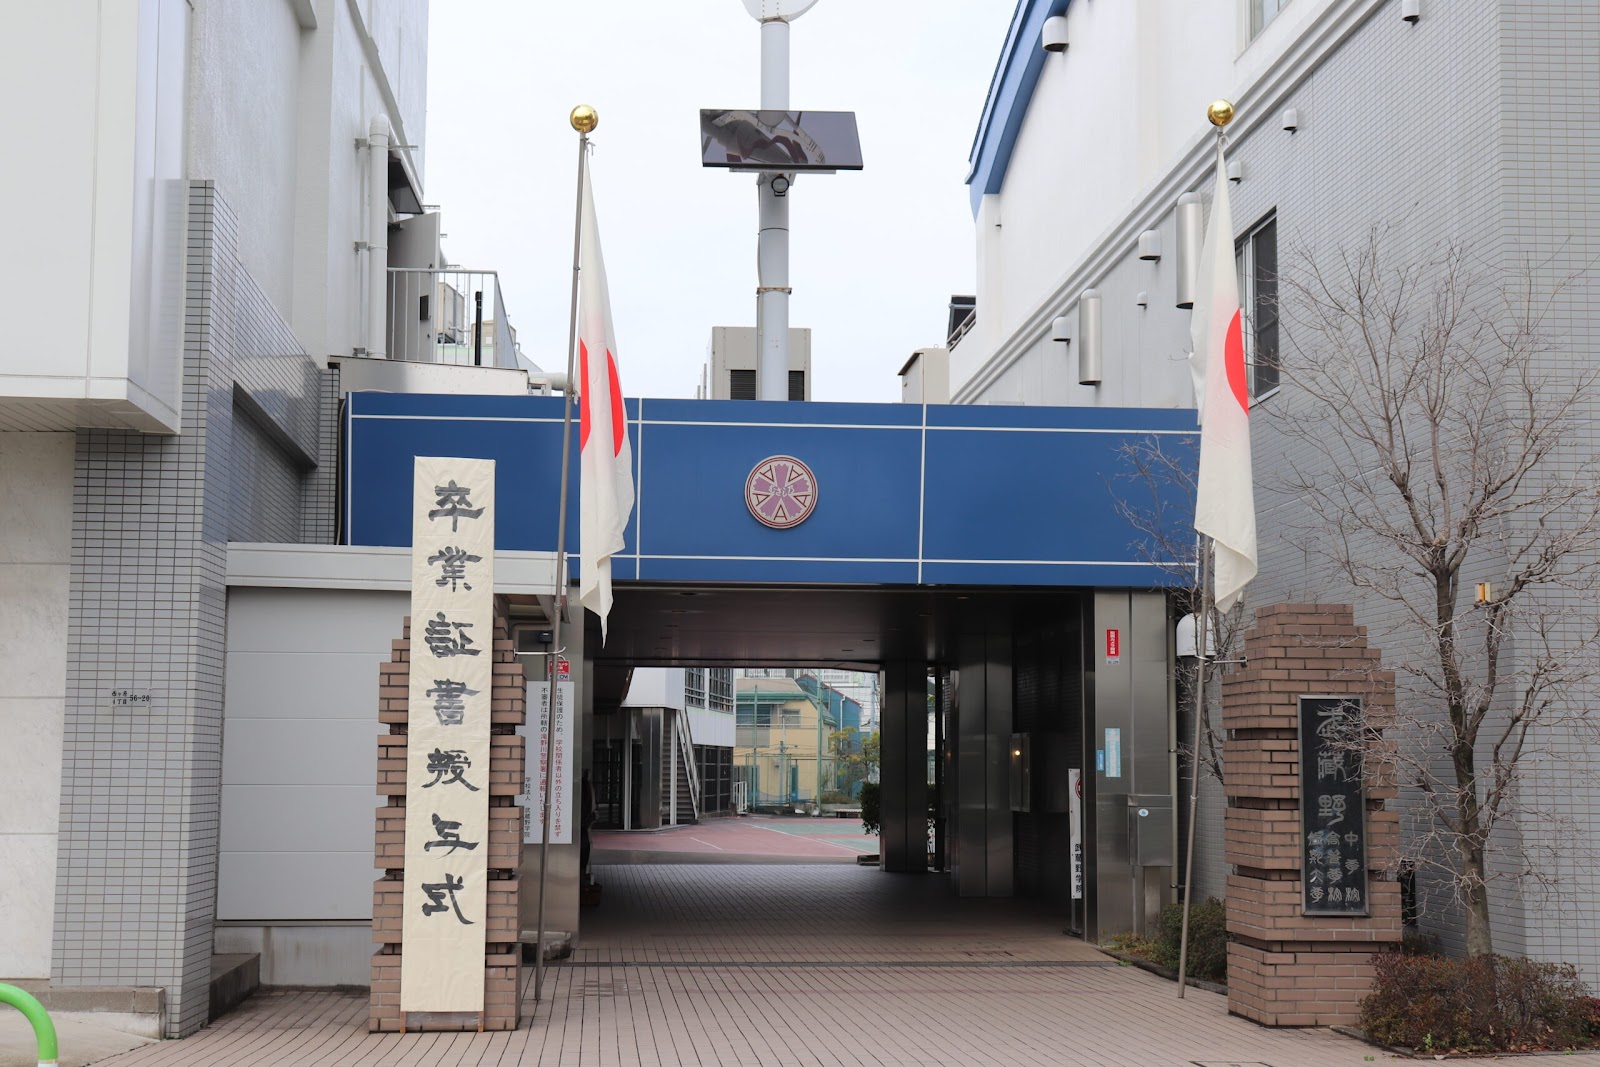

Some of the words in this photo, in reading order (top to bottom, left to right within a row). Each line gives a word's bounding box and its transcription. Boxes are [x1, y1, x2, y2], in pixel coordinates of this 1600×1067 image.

[421, 479, 486, 925] 卒業証書授与式
